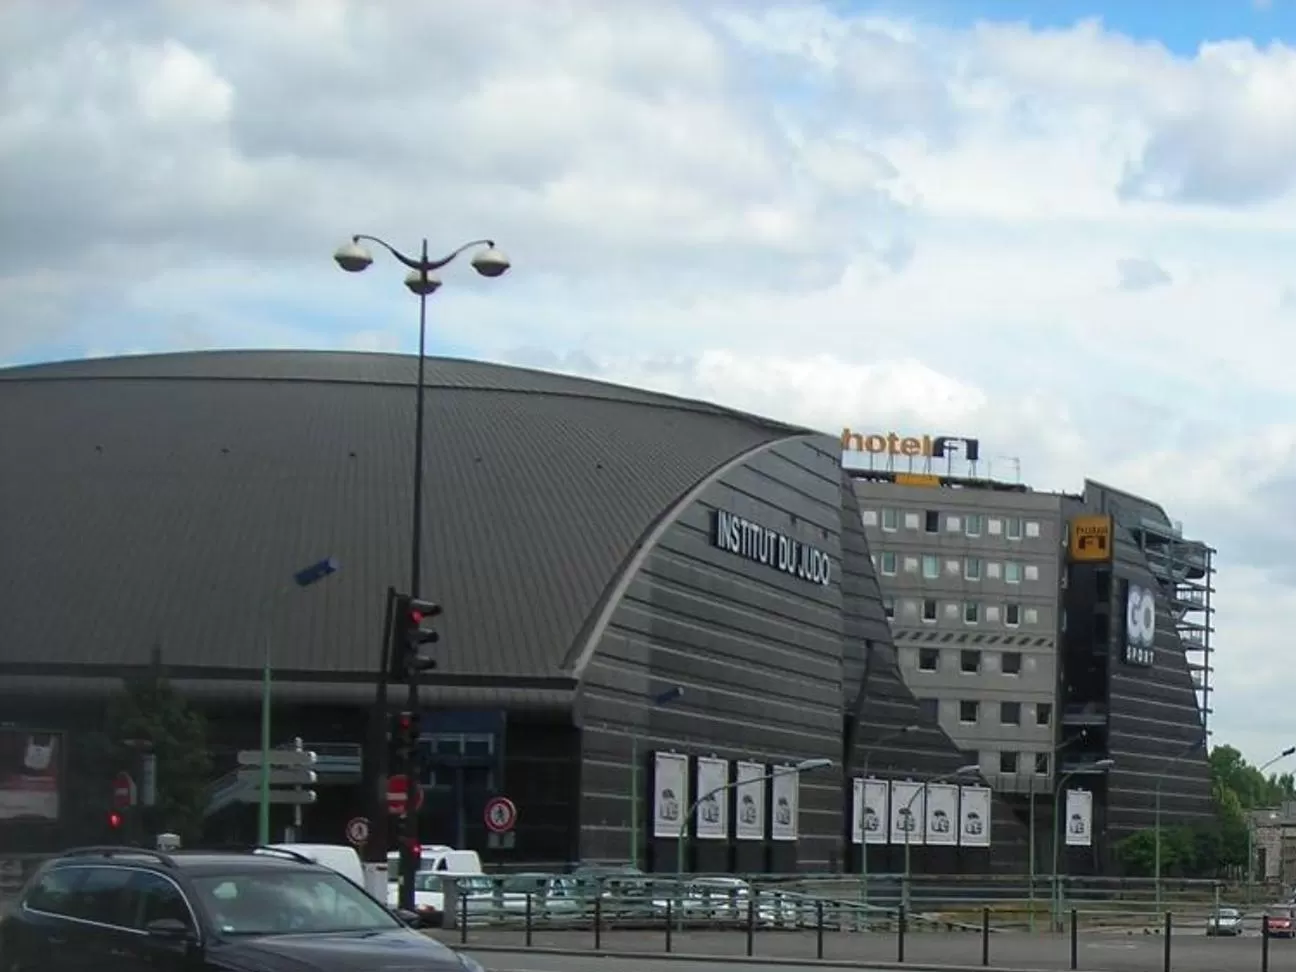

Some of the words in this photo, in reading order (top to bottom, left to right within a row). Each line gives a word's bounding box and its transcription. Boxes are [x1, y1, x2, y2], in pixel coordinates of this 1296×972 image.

[841, 428, 930, 456] hotel
[718, 509, 776, 566] INSTITUT
[779, 535, 796, 573] DU
[798, 545, 830, 586] JUDO
[1127, 584, 1155, 647] GO
[1126, 646, 1154, 664] SPORT
